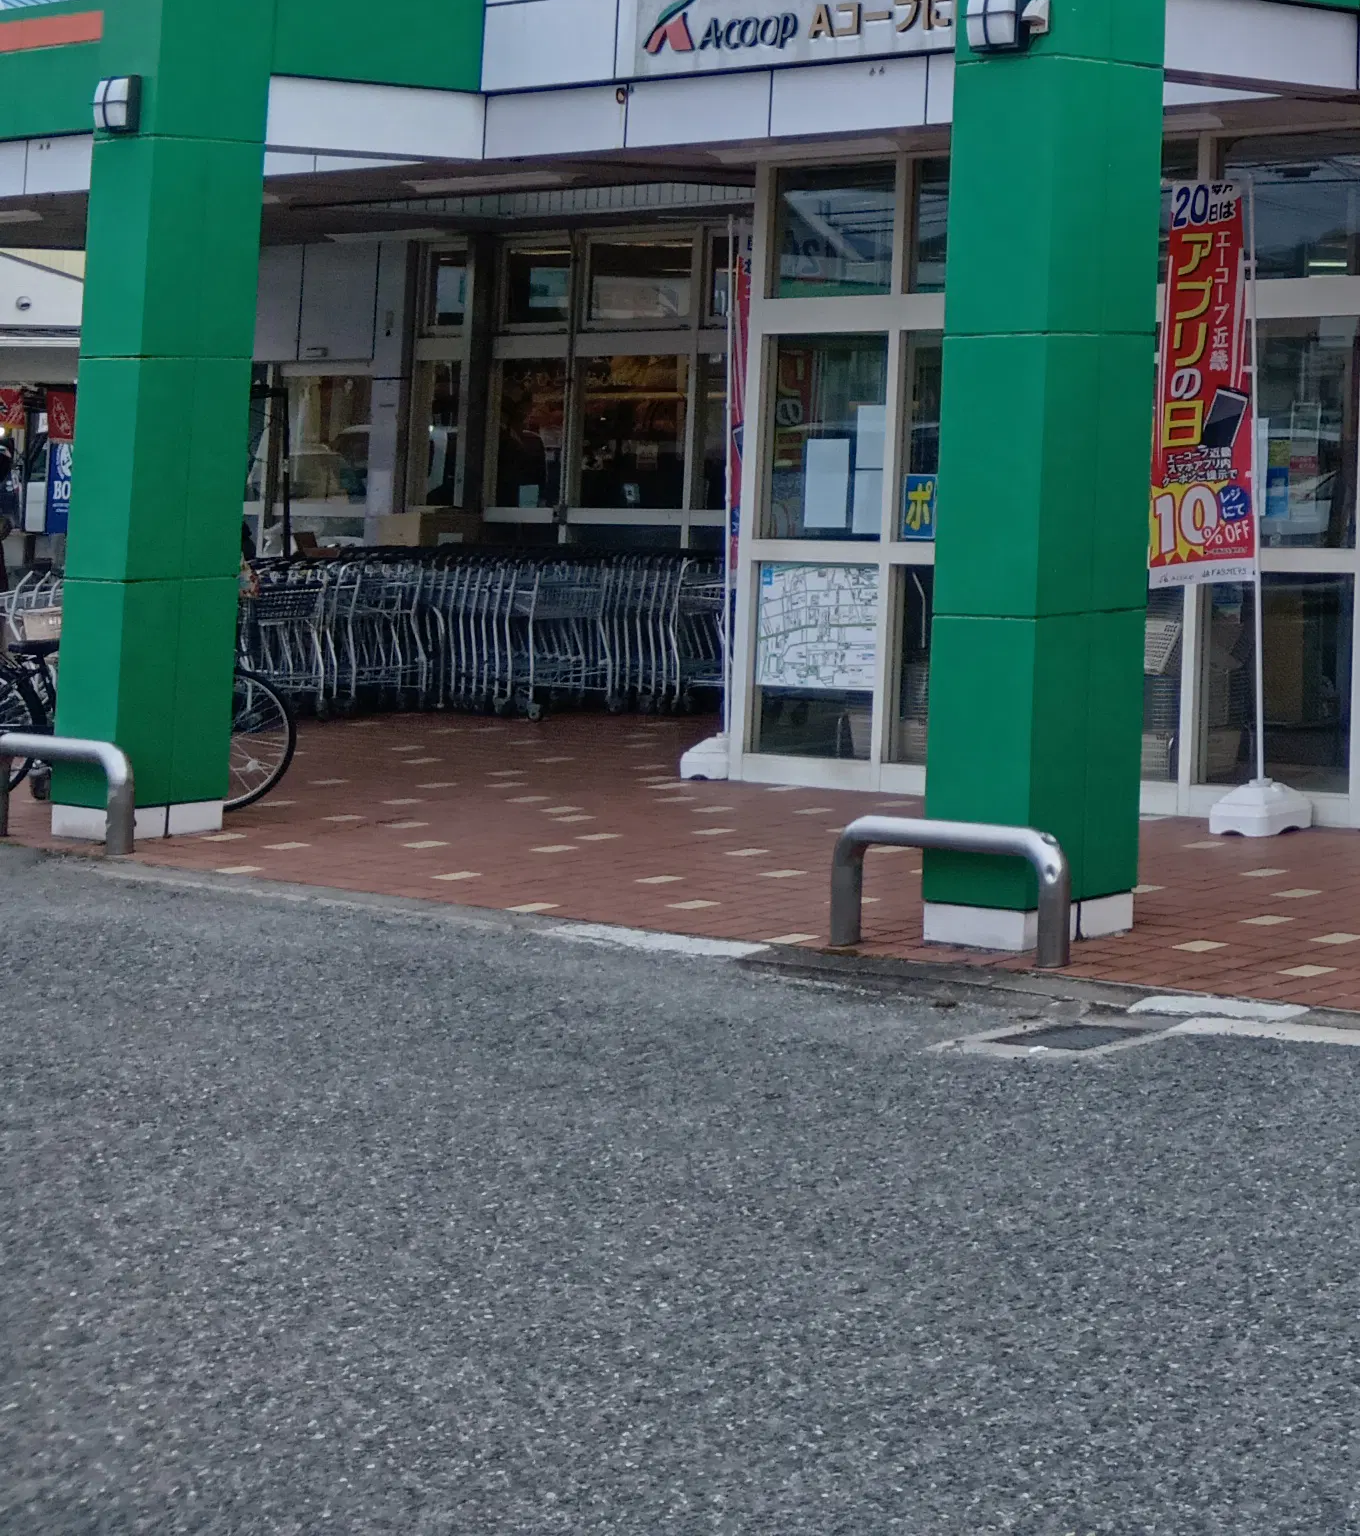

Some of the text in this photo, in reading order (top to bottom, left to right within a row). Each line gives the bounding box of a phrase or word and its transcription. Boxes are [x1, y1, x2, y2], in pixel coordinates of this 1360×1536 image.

[1208, 230, 1232, 372] エーコープ近畿
[1163, 232, 1215, 449] アプリの日
[53, 480, 70, 500] BO
[1220, 488, 1241, 503] レジ
[906, 480, 933, 531] ポ
[1222, 503, 1246, 519] にて
[1225, 520, 1250, 544] OFF
